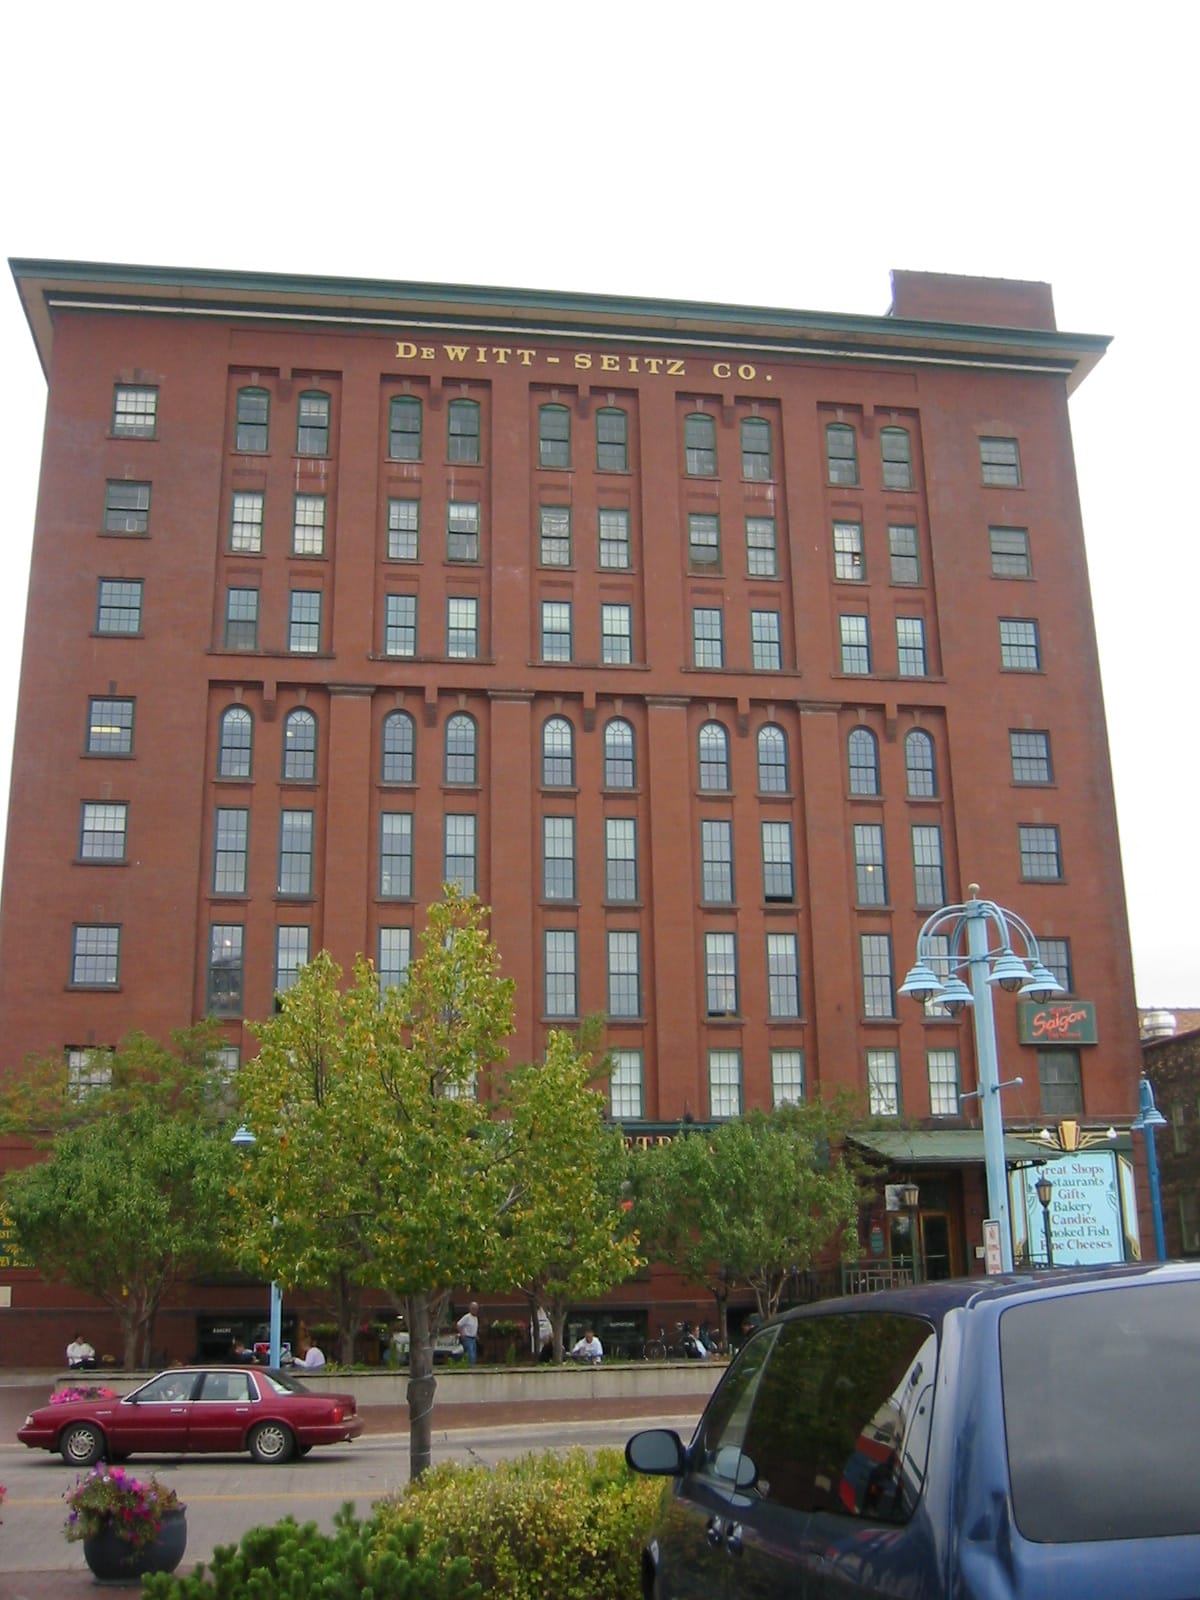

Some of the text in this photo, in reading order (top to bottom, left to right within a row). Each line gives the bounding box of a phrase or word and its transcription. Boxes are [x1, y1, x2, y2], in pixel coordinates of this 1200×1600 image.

[574, 353, 686, 376] SEITZ
[1031, 1009, 1087, 1037] Saigon
[1036, 1163, 1105, 1177] Great Shops
[1051, 1177, 1105, 1187] staurants
[1058, 1189, 1086, 1199] Gifts
[1053, 1201, 1093, 1214] Bakery
[1051, 1214, 1097, 1225] Candies
[1087, 1225, 1110, 1237] Fish
[1040, 1239, 1113, 1250] Fne Cheeses
